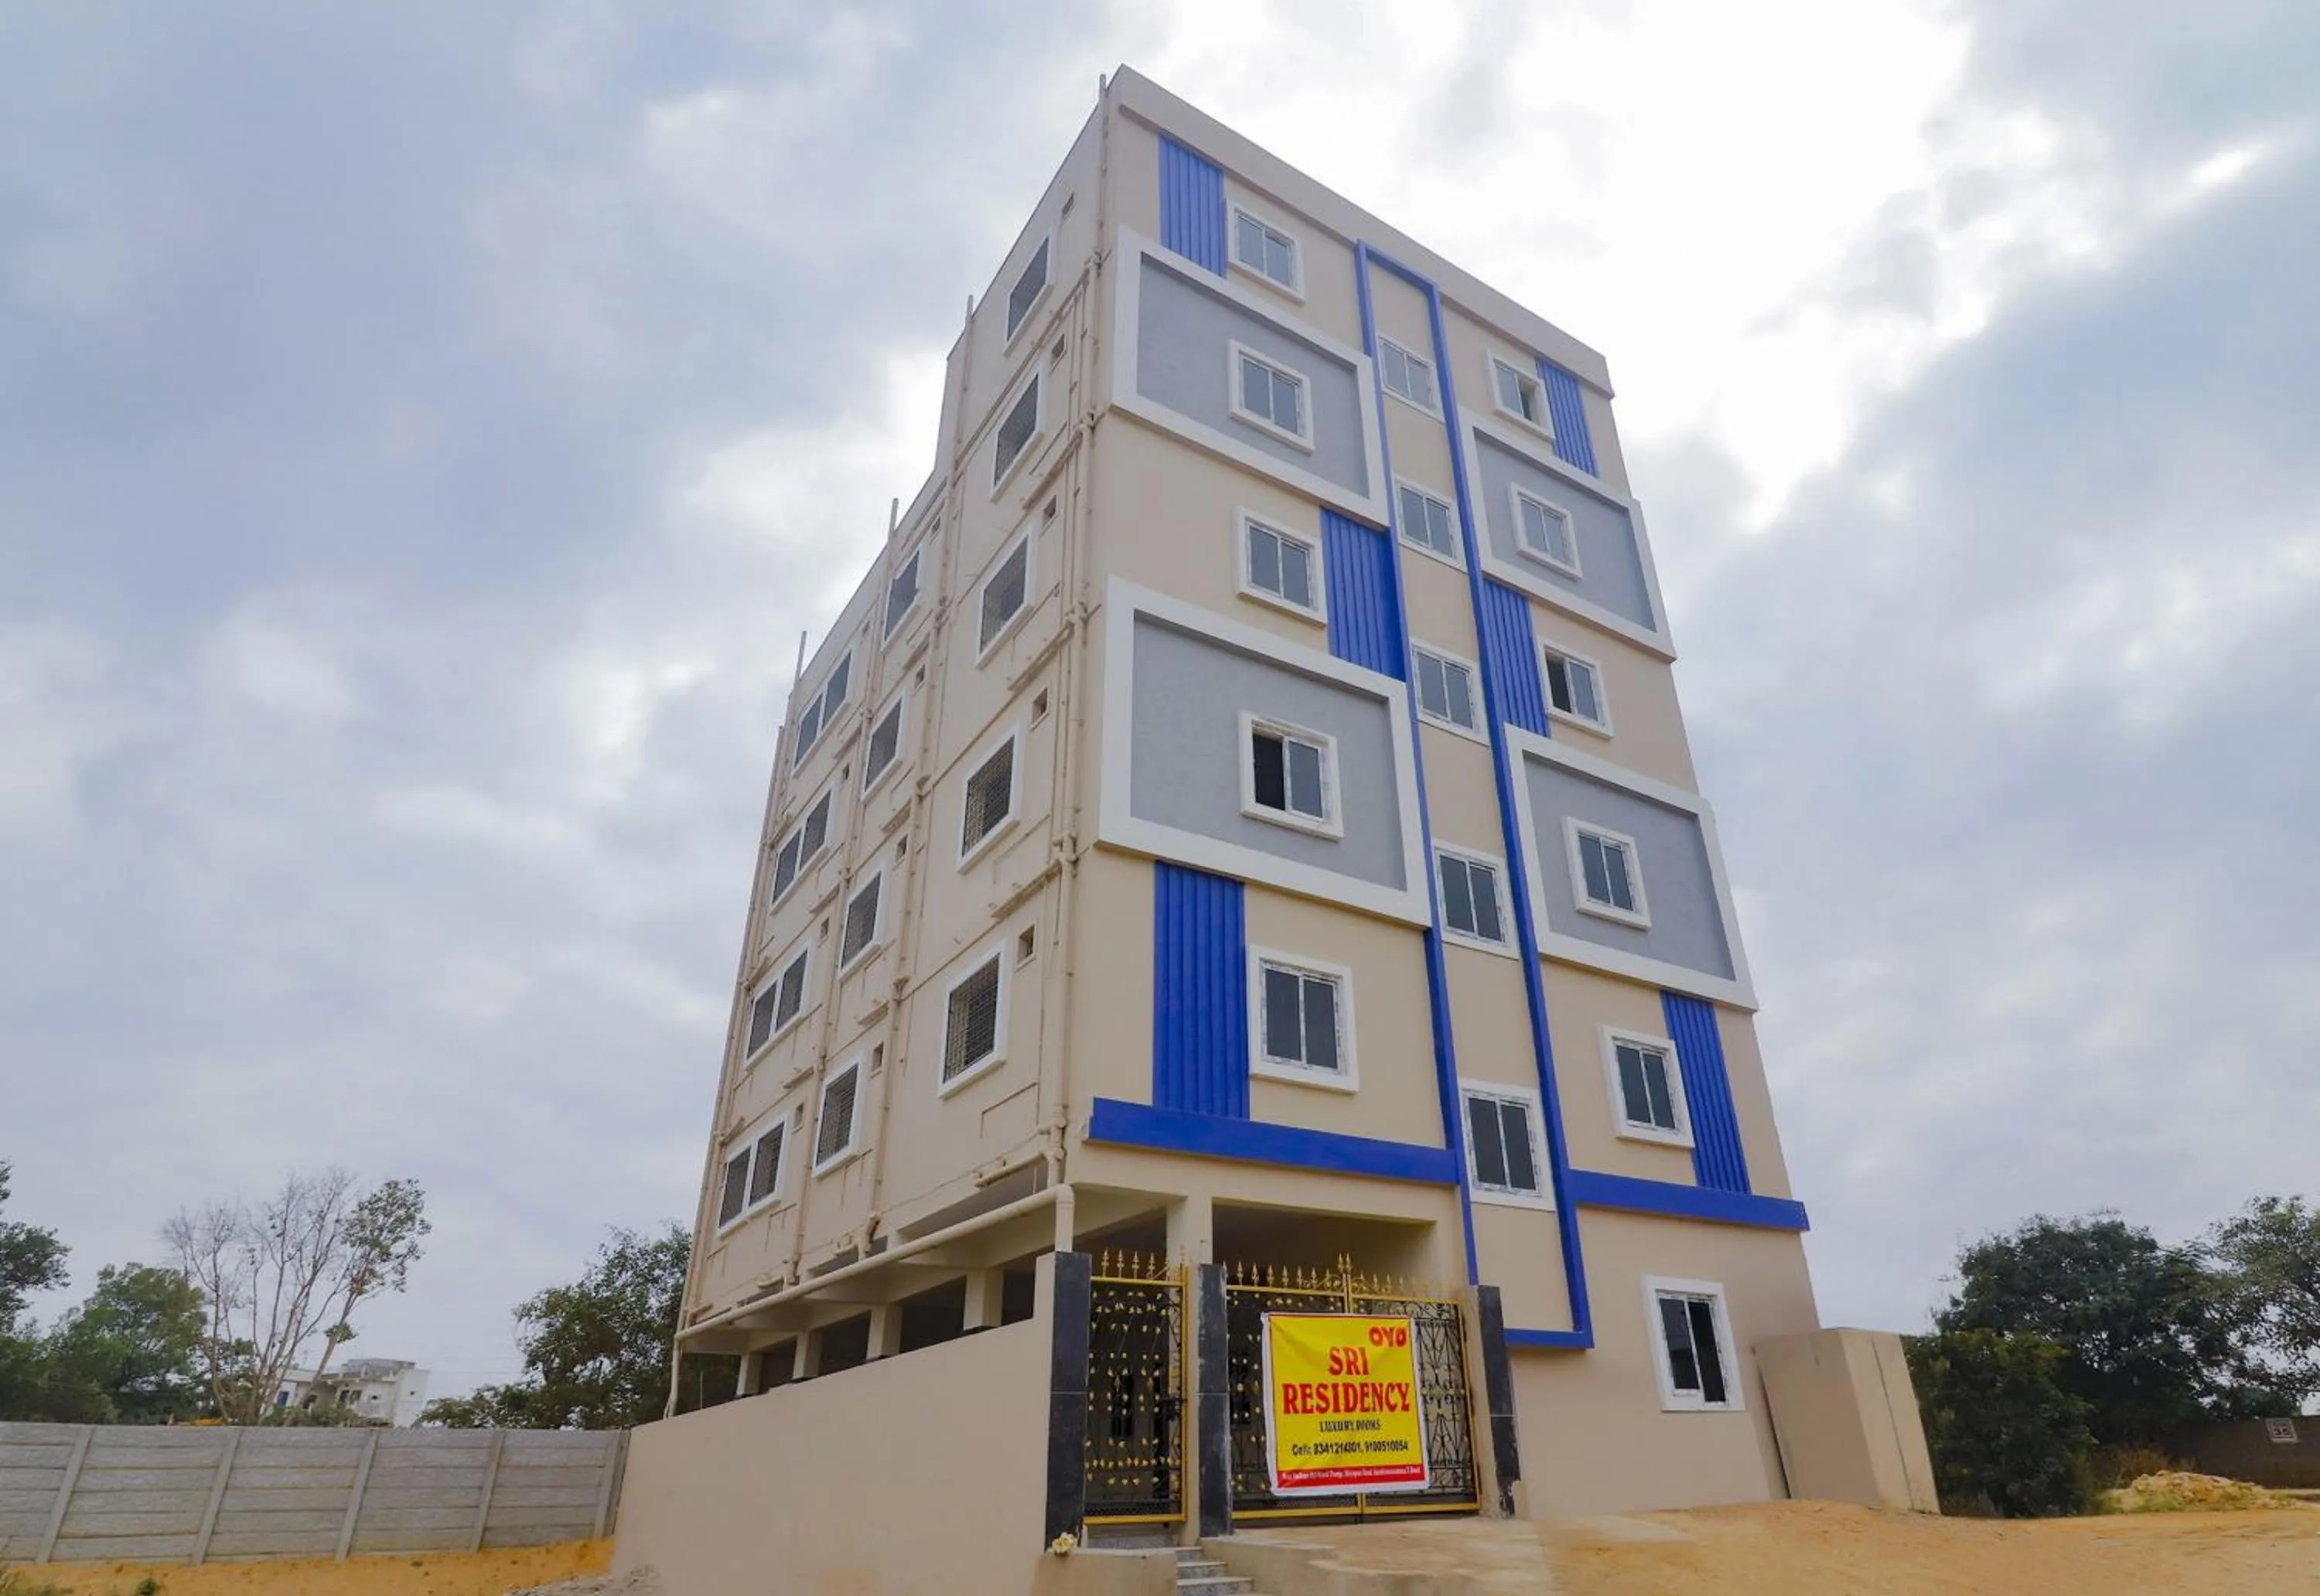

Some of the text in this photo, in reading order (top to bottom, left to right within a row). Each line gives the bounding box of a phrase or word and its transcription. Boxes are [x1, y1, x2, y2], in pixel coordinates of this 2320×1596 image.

[1369, 1326, 1407, 1347] OYO
[1329, 1346, 1369, 1376] SRI
[1282, 1383, 1410, 1414] RESIDENCY
